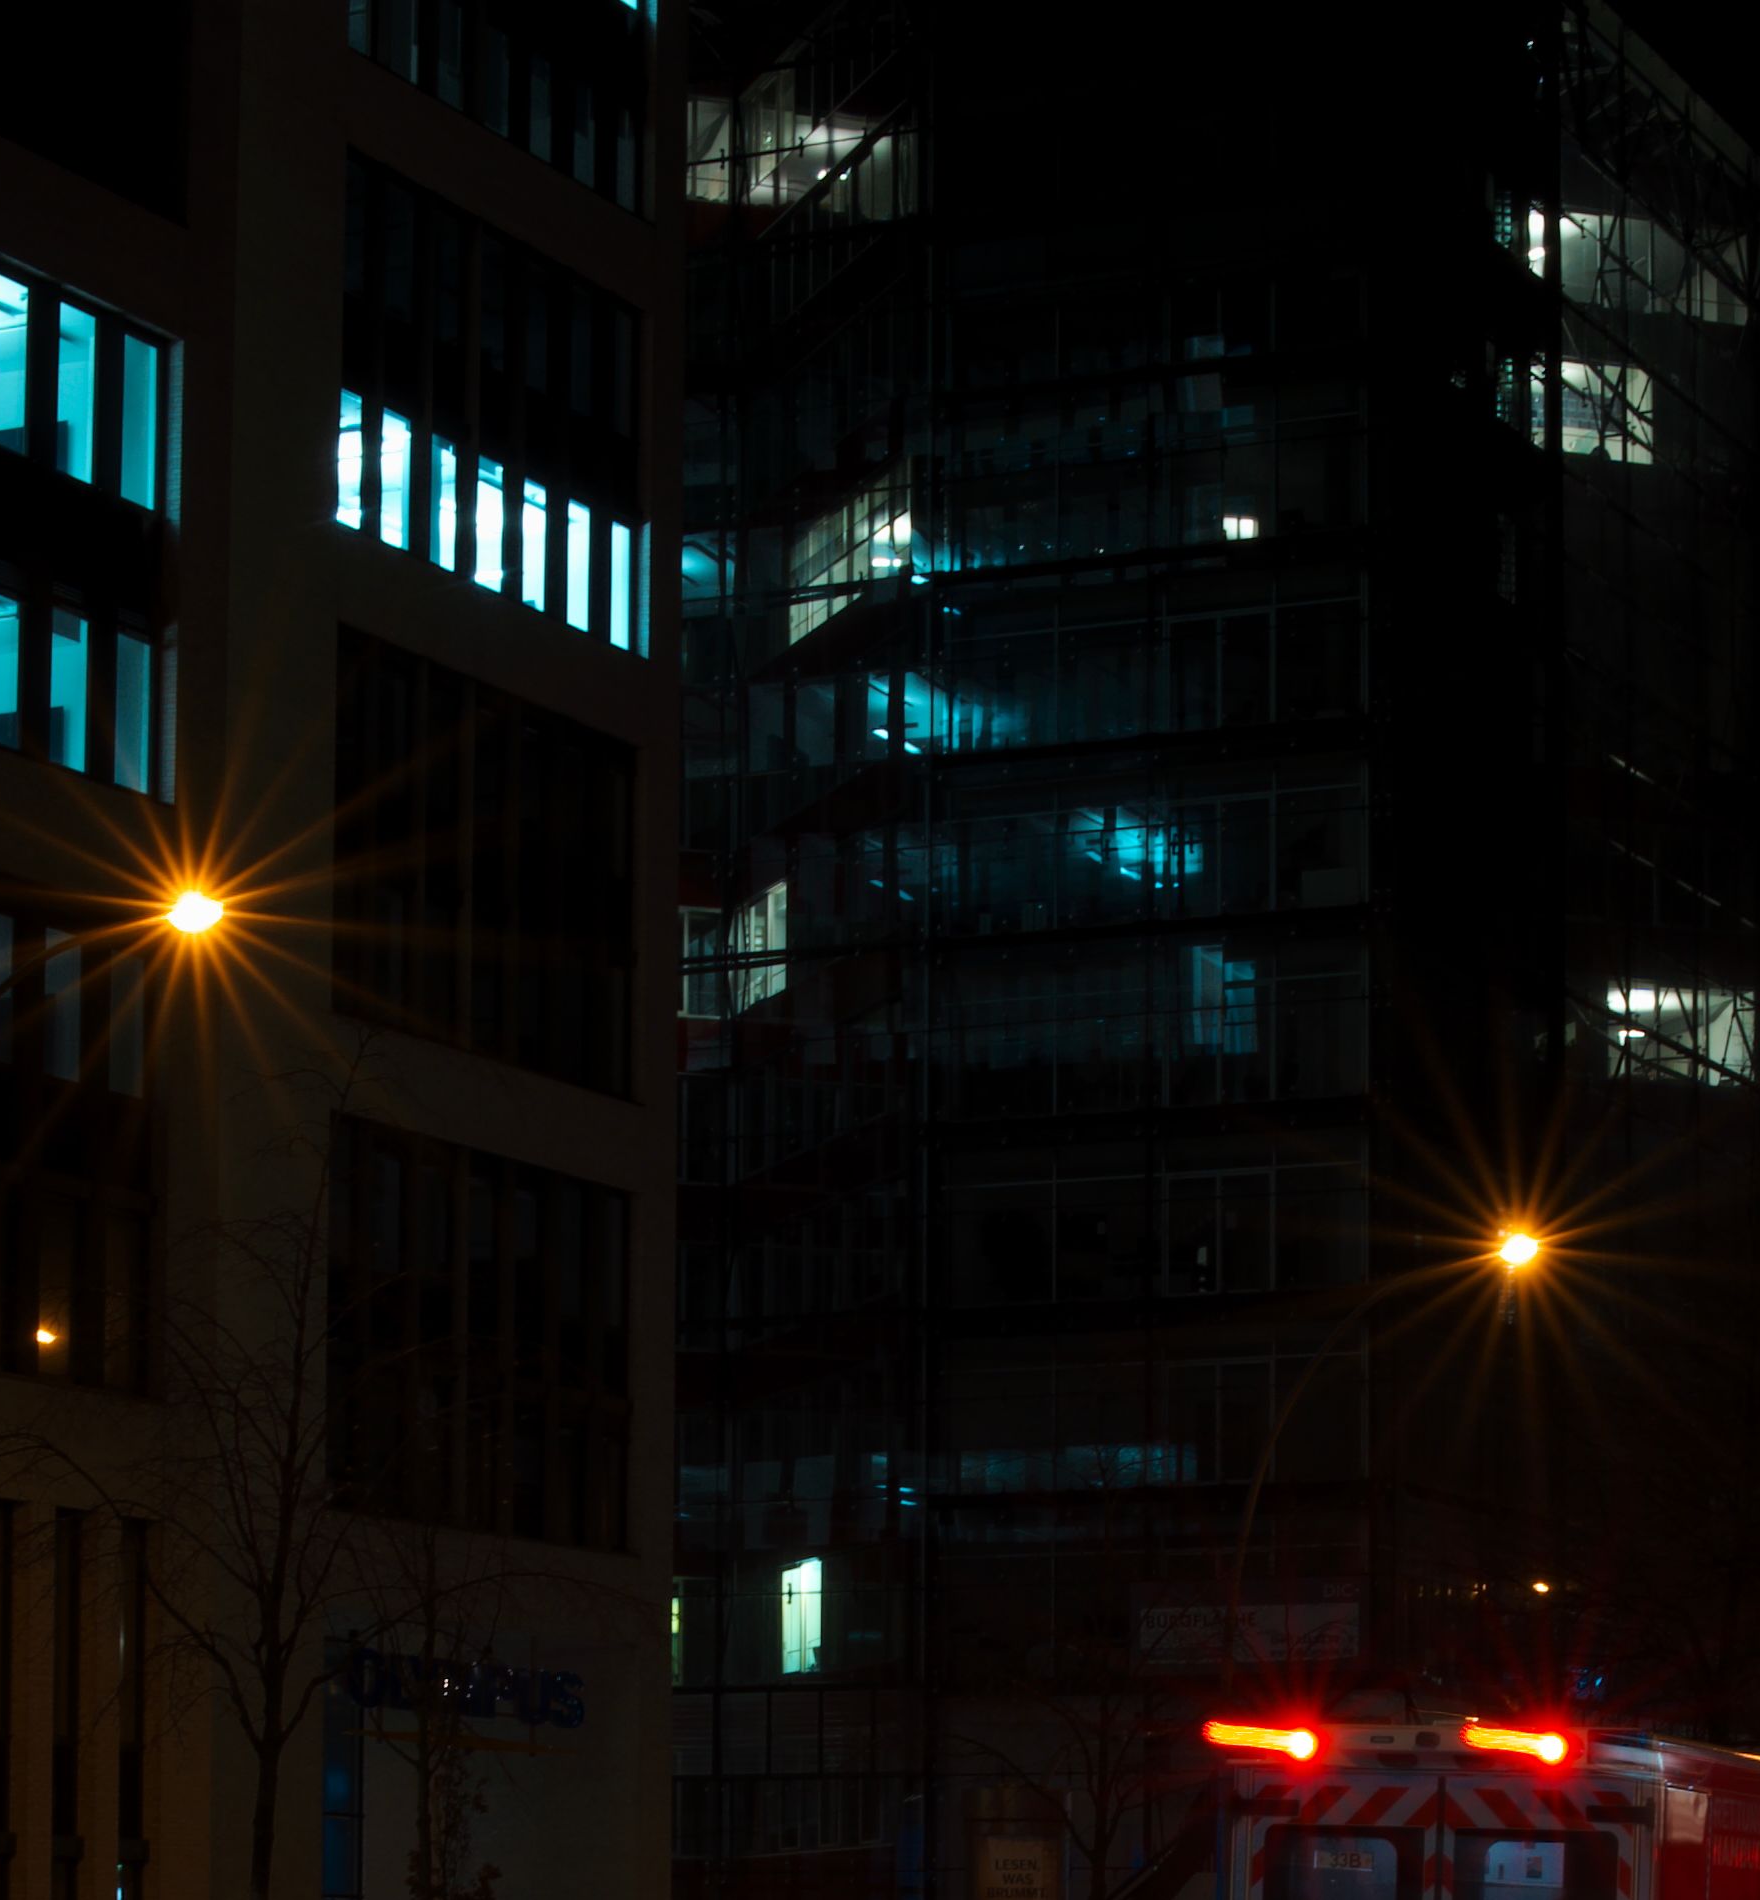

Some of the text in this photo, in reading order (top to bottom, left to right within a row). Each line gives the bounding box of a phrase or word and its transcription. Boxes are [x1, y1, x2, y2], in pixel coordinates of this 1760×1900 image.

[1145, 1607, 1256, 1629] BÜROFLÄHE
[995, 1858, 1041, 1872] LESEN,
[1329, 1852, 1362, 1868] 33B
[1002, 1873, 1034, 1885] WAS
